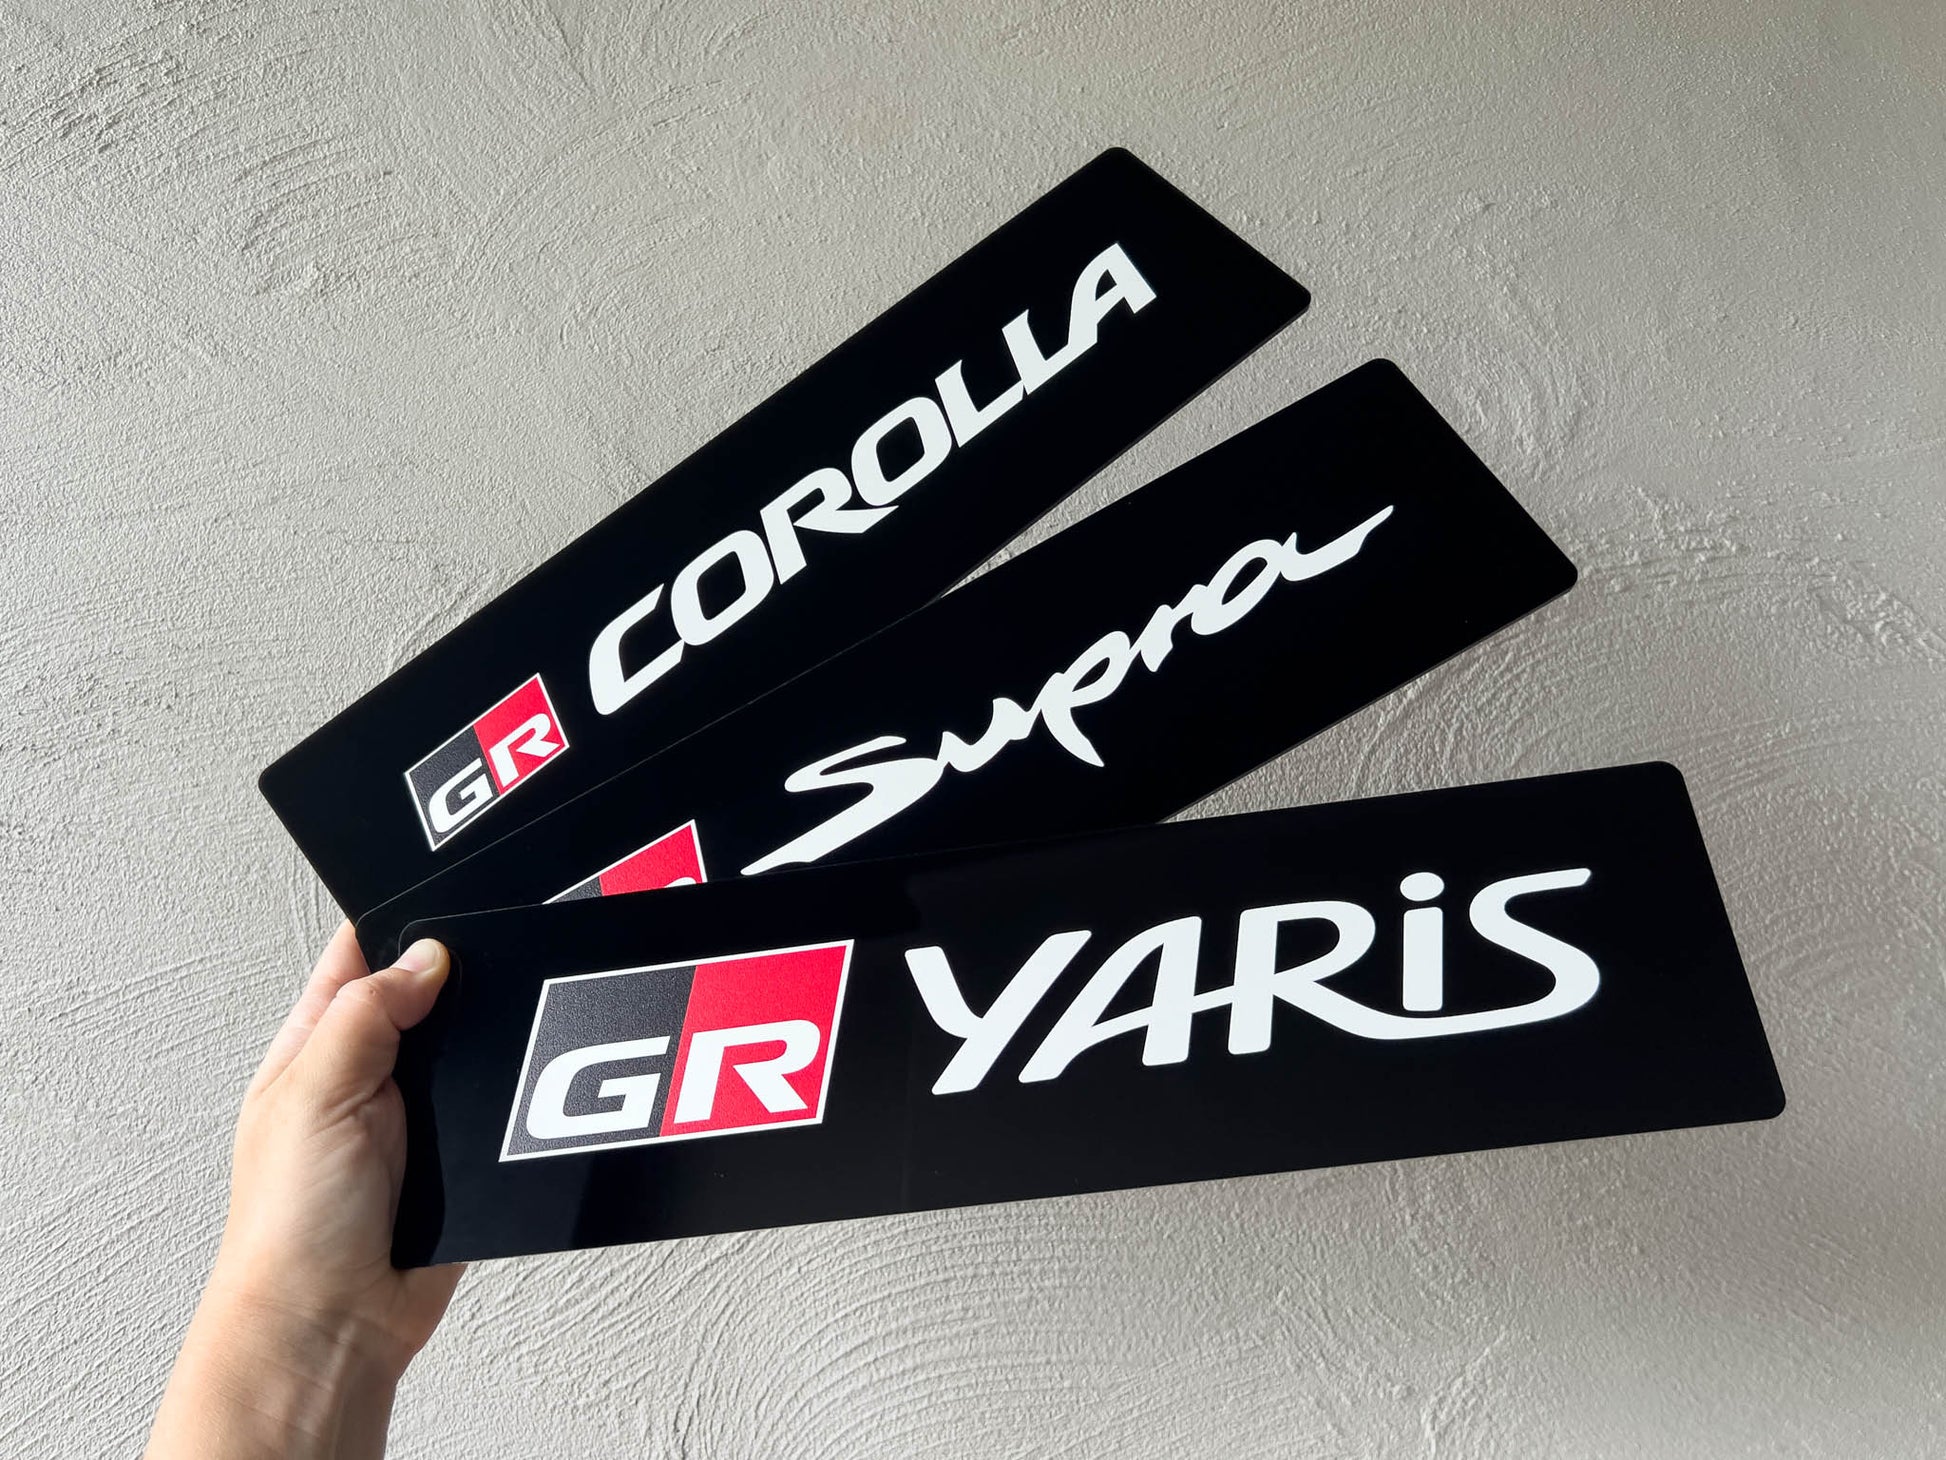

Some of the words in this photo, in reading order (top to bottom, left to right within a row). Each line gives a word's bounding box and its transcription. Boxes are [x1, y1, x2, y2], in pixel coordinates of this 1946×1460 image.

[428, 713, 560, 833] GR
[588, 242, 1157, 716] COROLLA
[740, 504, 1394, 876] Supra
[525, 1019, 821, 1140] GR
